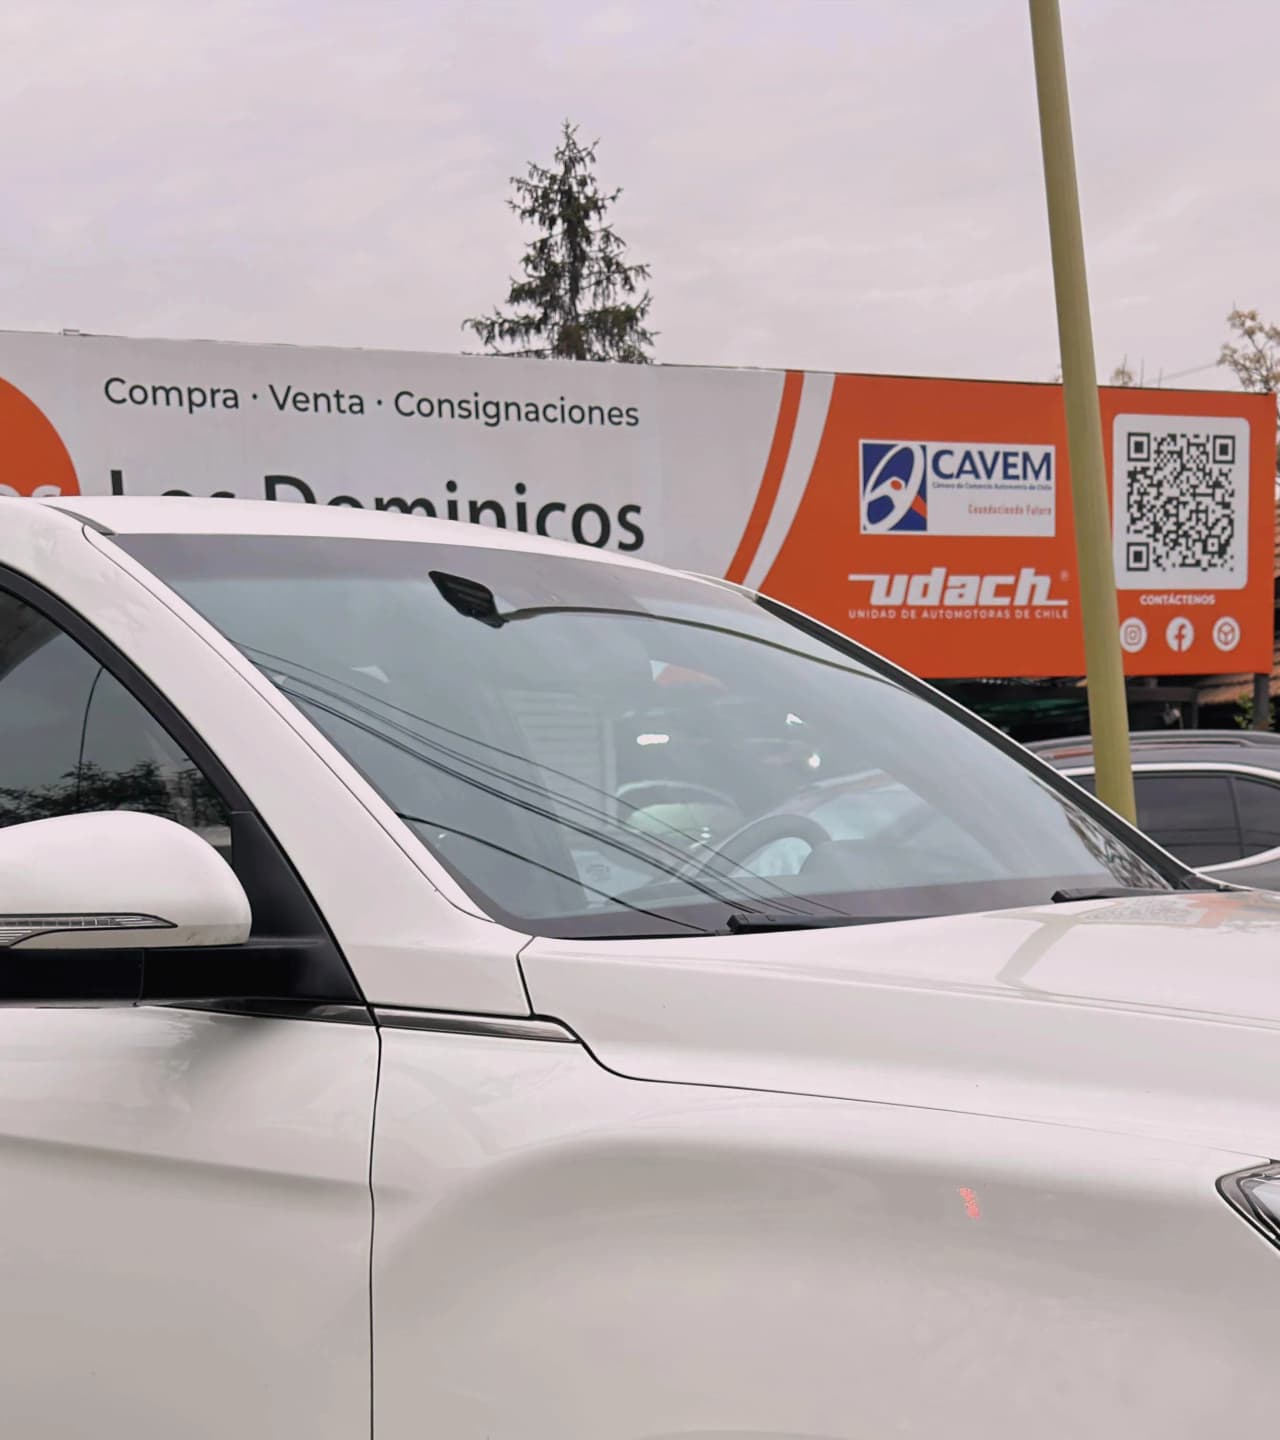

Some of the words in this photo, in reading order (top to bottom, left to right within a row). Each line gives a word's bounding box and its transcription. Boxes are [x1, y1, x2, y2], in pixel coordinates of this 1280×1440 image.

[104, 377, 239, 415] Compra
[268, 384, 365, 415] Venta
[394, 390, 639, 428] Consignaciones
[932, 449, 1051, 481] CAVEM
[848, 566, 1069, 607] udach
[1139, 591, 1216, 607] CONTÁCTENOS
[847, 609, 897, 620] UNIDAD
[901, 609, 917, 620] DE
[922, 609, 1011, 620] AUTOMOTORAS
[1015, 609, 1031, 620] DE
[1035, 609, 1069, 620] CHILE
